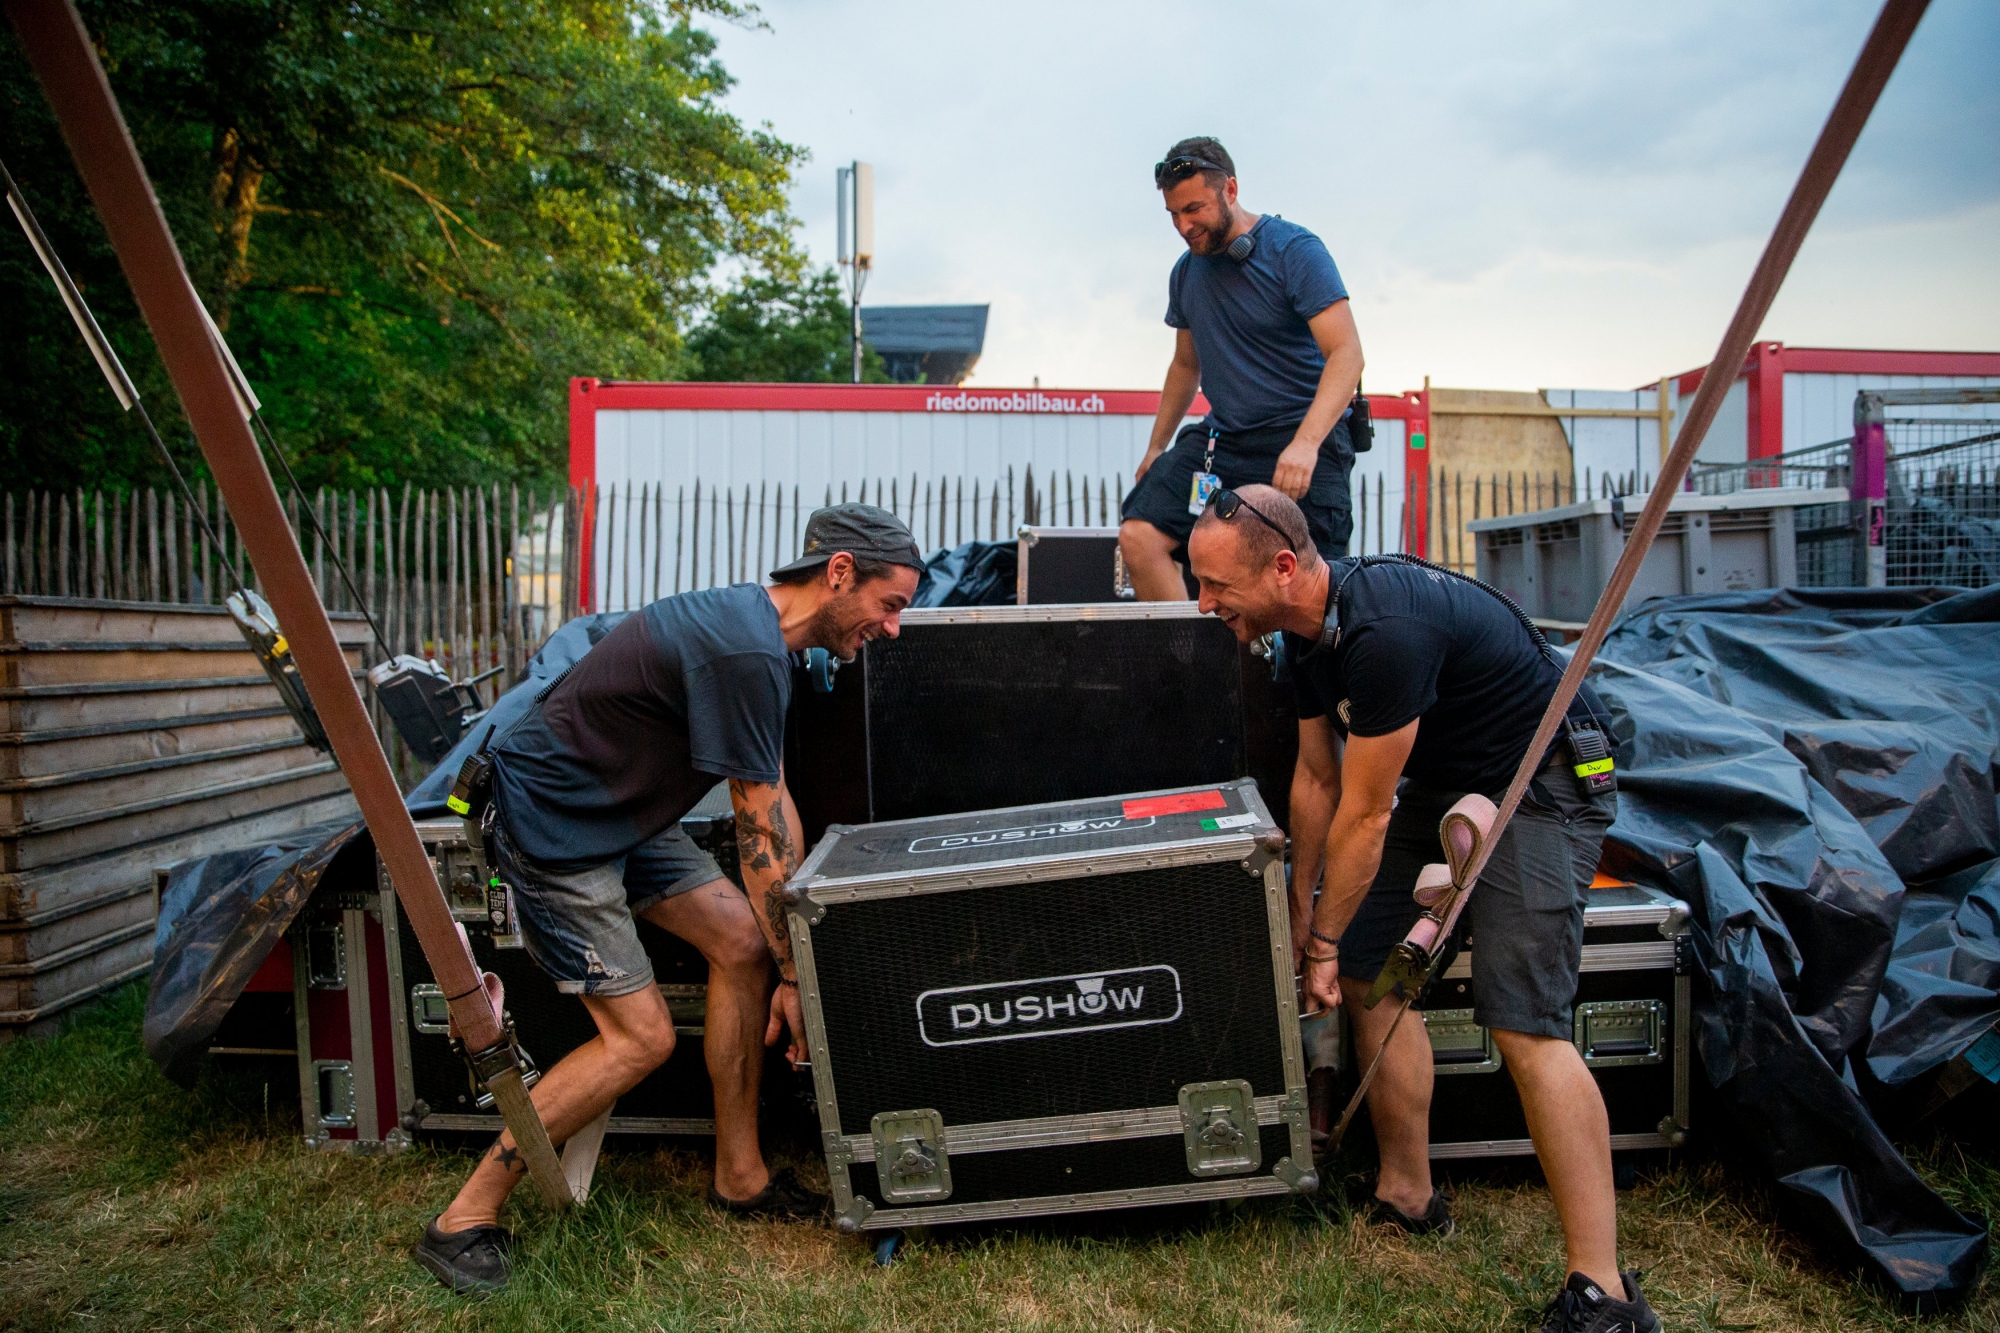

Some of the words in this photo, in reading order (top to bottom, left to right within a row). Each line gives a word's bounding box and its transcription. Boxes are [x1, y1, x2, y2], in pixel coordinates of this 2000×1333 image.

[926, 392, 1105, 412] riedomobilbau.ch
[941, 819, 1121, 847] DUSHOW
[490, 891, 506, 900] CLUB
[490, 899, 506, 908] TENT
[951, 984, 1144, 1029] DUSHOW
